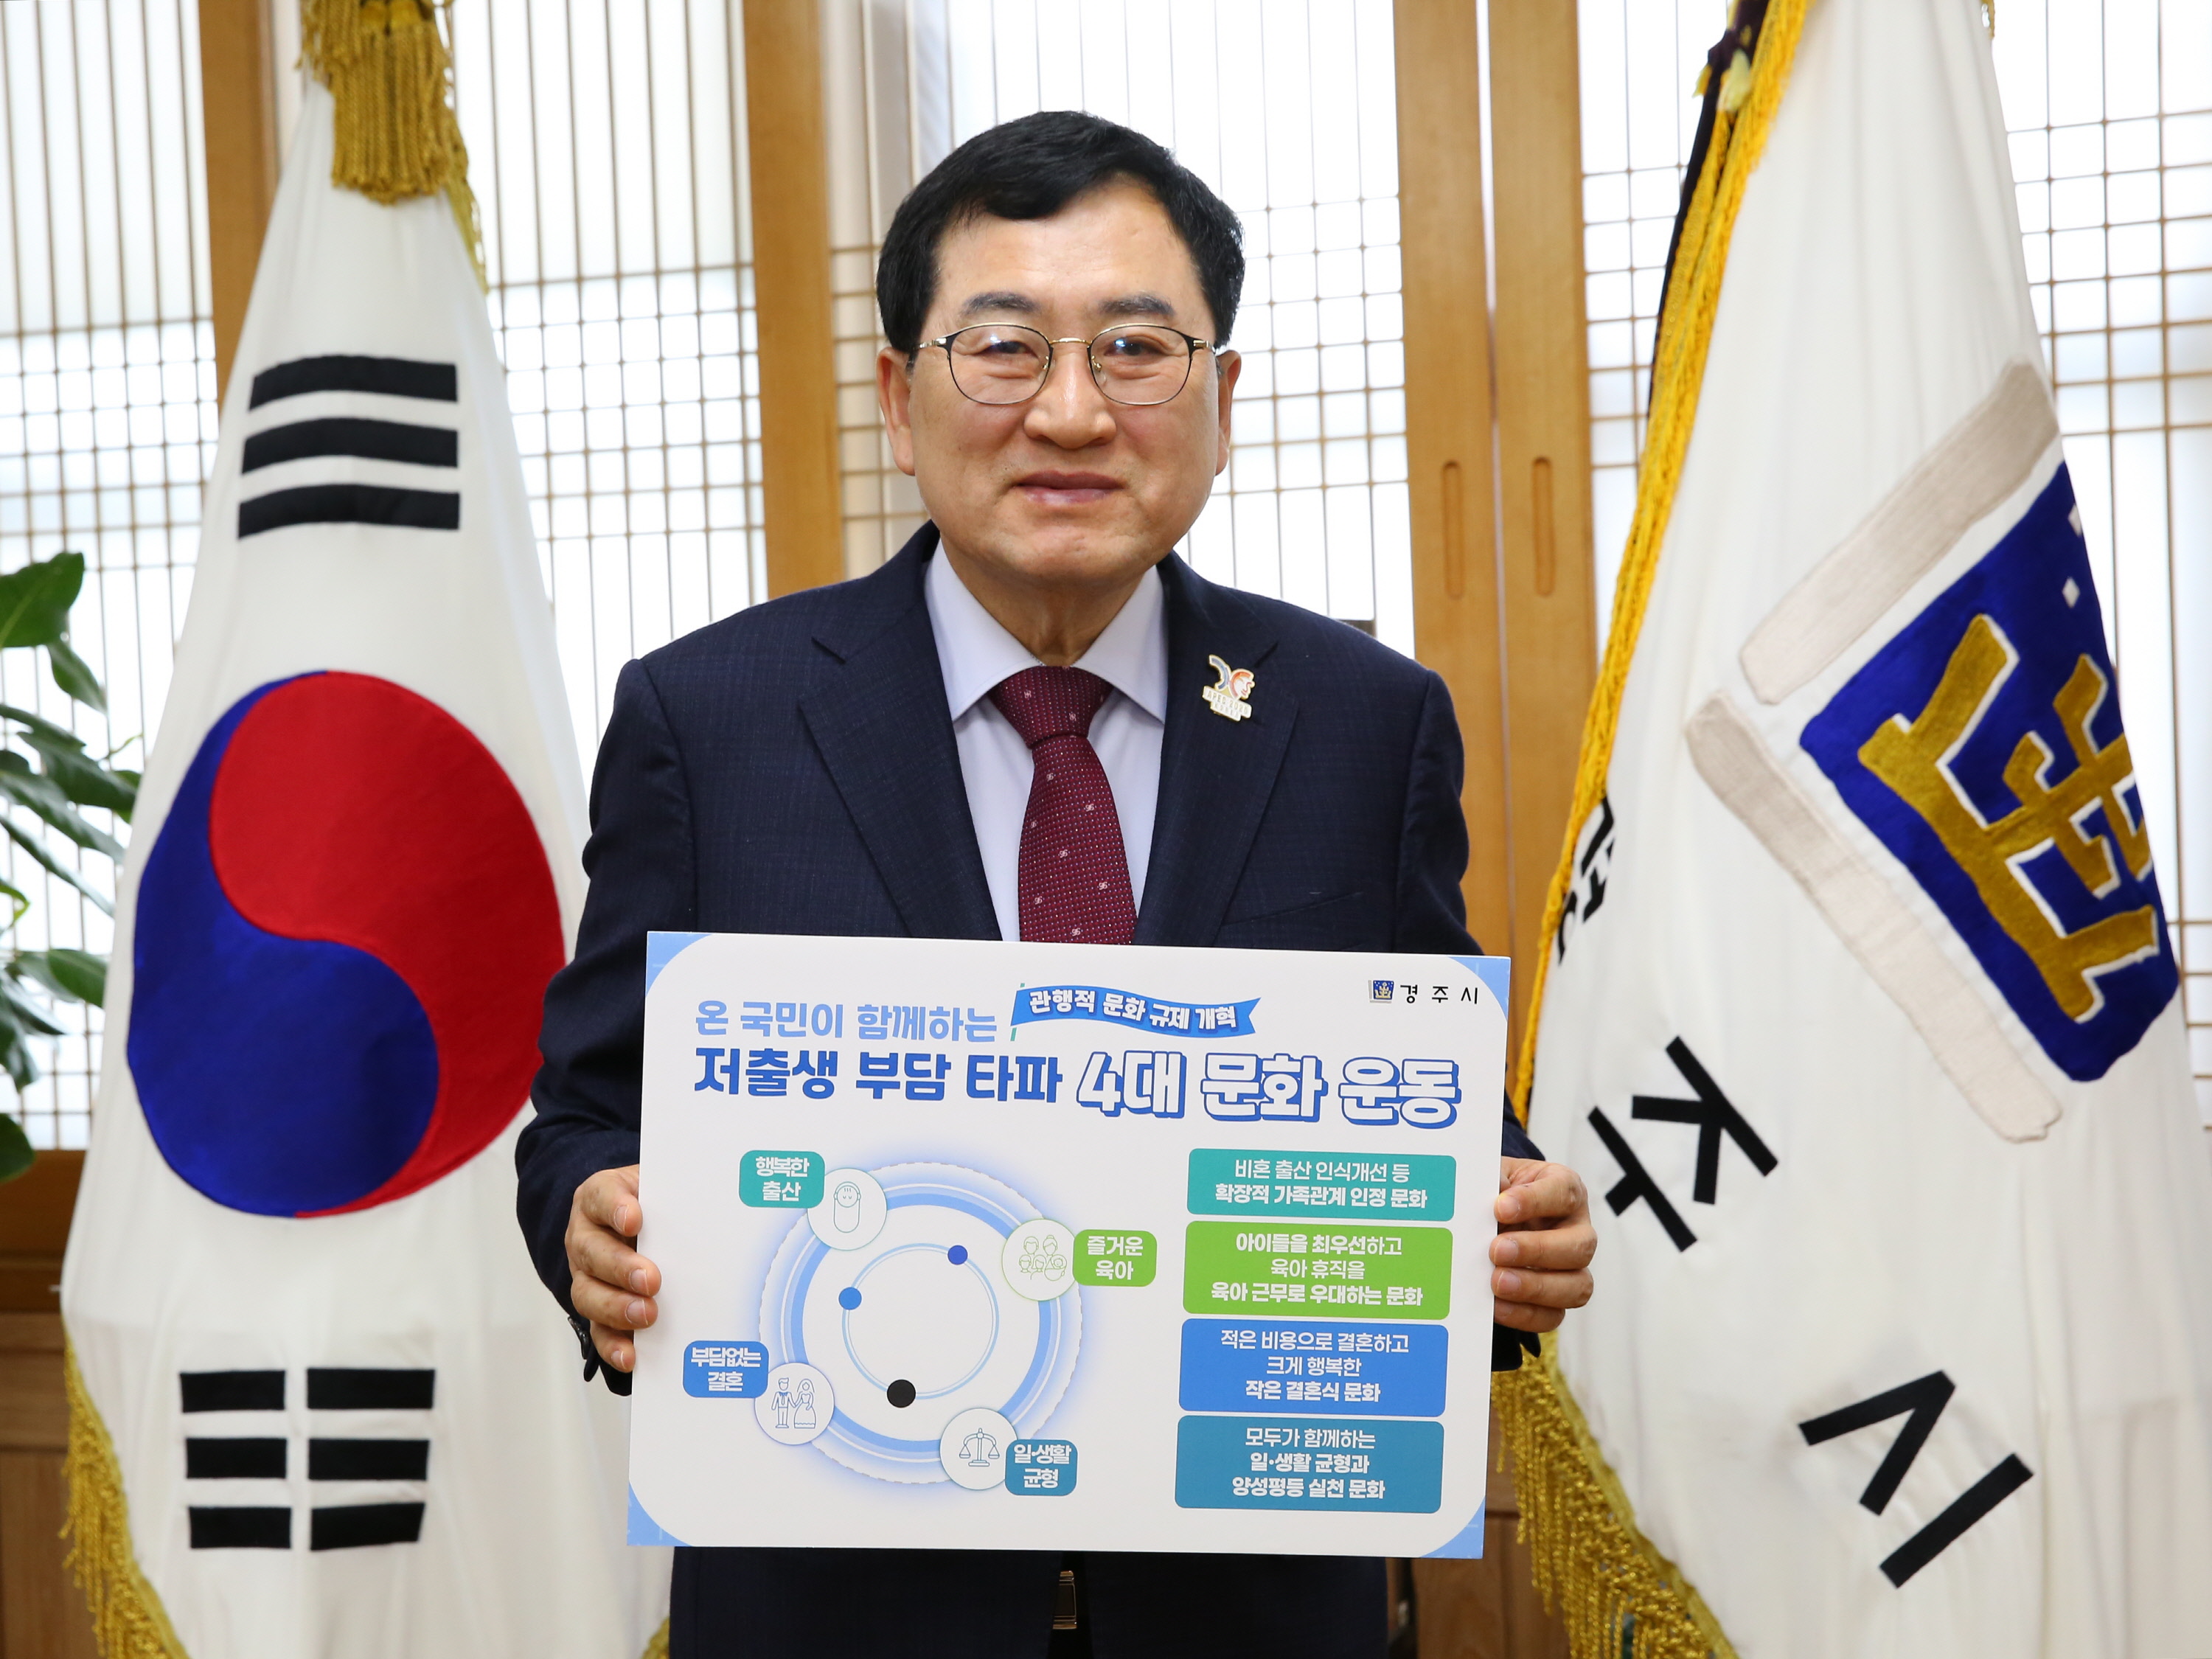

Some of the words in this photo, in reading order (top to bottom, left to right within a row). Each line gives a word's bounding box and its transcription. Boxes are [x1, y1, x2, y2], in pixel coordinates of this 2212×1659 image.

[1030, 990, 1095, 1013] 관행적
[1103, 993, 1146, 1020] 문화
[1150, 1004, 1190, 1029] 규제
[1195, 1006, 1236, 1029] 개혁
[696, 1001, 728, 1034] 온
[741, 1002, 843, 1037] 국민이
[858, 1004, 996, 1042] 함께하는
[695, 1048, 838, 1099] 저출생
[856, 1052, 951, 1100] 부담
[967, 1055, 1062, 1102] 타파
[1077, 1051, 1187, 1119] 4대
[1200, 1053, 1329, 1122] 문화
[1338, 1057, 1461, 1129] 운동
[756, 1156, 810, 1177] 행복한
[1236, 1159, 1270, 1178] 비혼
[1276, 1160, 1312, 1180] 출산
[1316, 1161, 1387, 1182] 인식개선
[1392, 1164, 1410, 1183] 등
[762, 1180, 801, 1201] 출산
[1216, 1183, 1269, 1203] 확장적
[1274, 1186, 1346, 1206] 가족관계
[1351, 1188, 1386, 1207] 인정
[1391, 1189, 1427, 1208] 문화
[1088, 1236, 1143, 1256] 즐거운
[1237, 1234, 1308, 1253] 아이들을
[1312, 1235, 1402, 1255] 최우선하고
[1096, 1260, 1133, 1280] 육아
[1271, 1259, 1307, 1278] 육아
[1311, 1259, 1365, 1279] 휴직을
[1211, 1282, 1248, 1301] 육아
[1252, 1283, 1306, 1302] 근무로
[1310, 1284, 1382, 1305] 우대하는
[1387, 1287, 1423, 1306] 문화
[1221, 1330, 1256, 1349] 적은
[1262, 1332, 1332, 1350] 비용으로
[1338, 1333, 1408, 1352] 결혼하고
[692, 1347, 761, 1367] 부담없는
[1267, 1357, 1302, 1374] 크게
[1307, 1357, 1362, 1377] 행복한
[709, 1371, 743, 1391] 결혼
[1246, 1380, 1281, 1399] 작은
[1287, 1381, 1339, 1401] 결혼식
[1344, 1382, 1380, 1402] 문화
[1245, 1427, 1300, 1447] 모두가
[1304, 1429, 1375, 1449] 함께하는
[1315, 1454, 1370, 1473] 균형과
[1023, 1468, 1058, 1488] 균형
[1232, 1477, 1304, 1497] 양성평등
[1309, 1479, 1344, 1498] 실천
[1349, 1479, 1385, 1498] 문화
